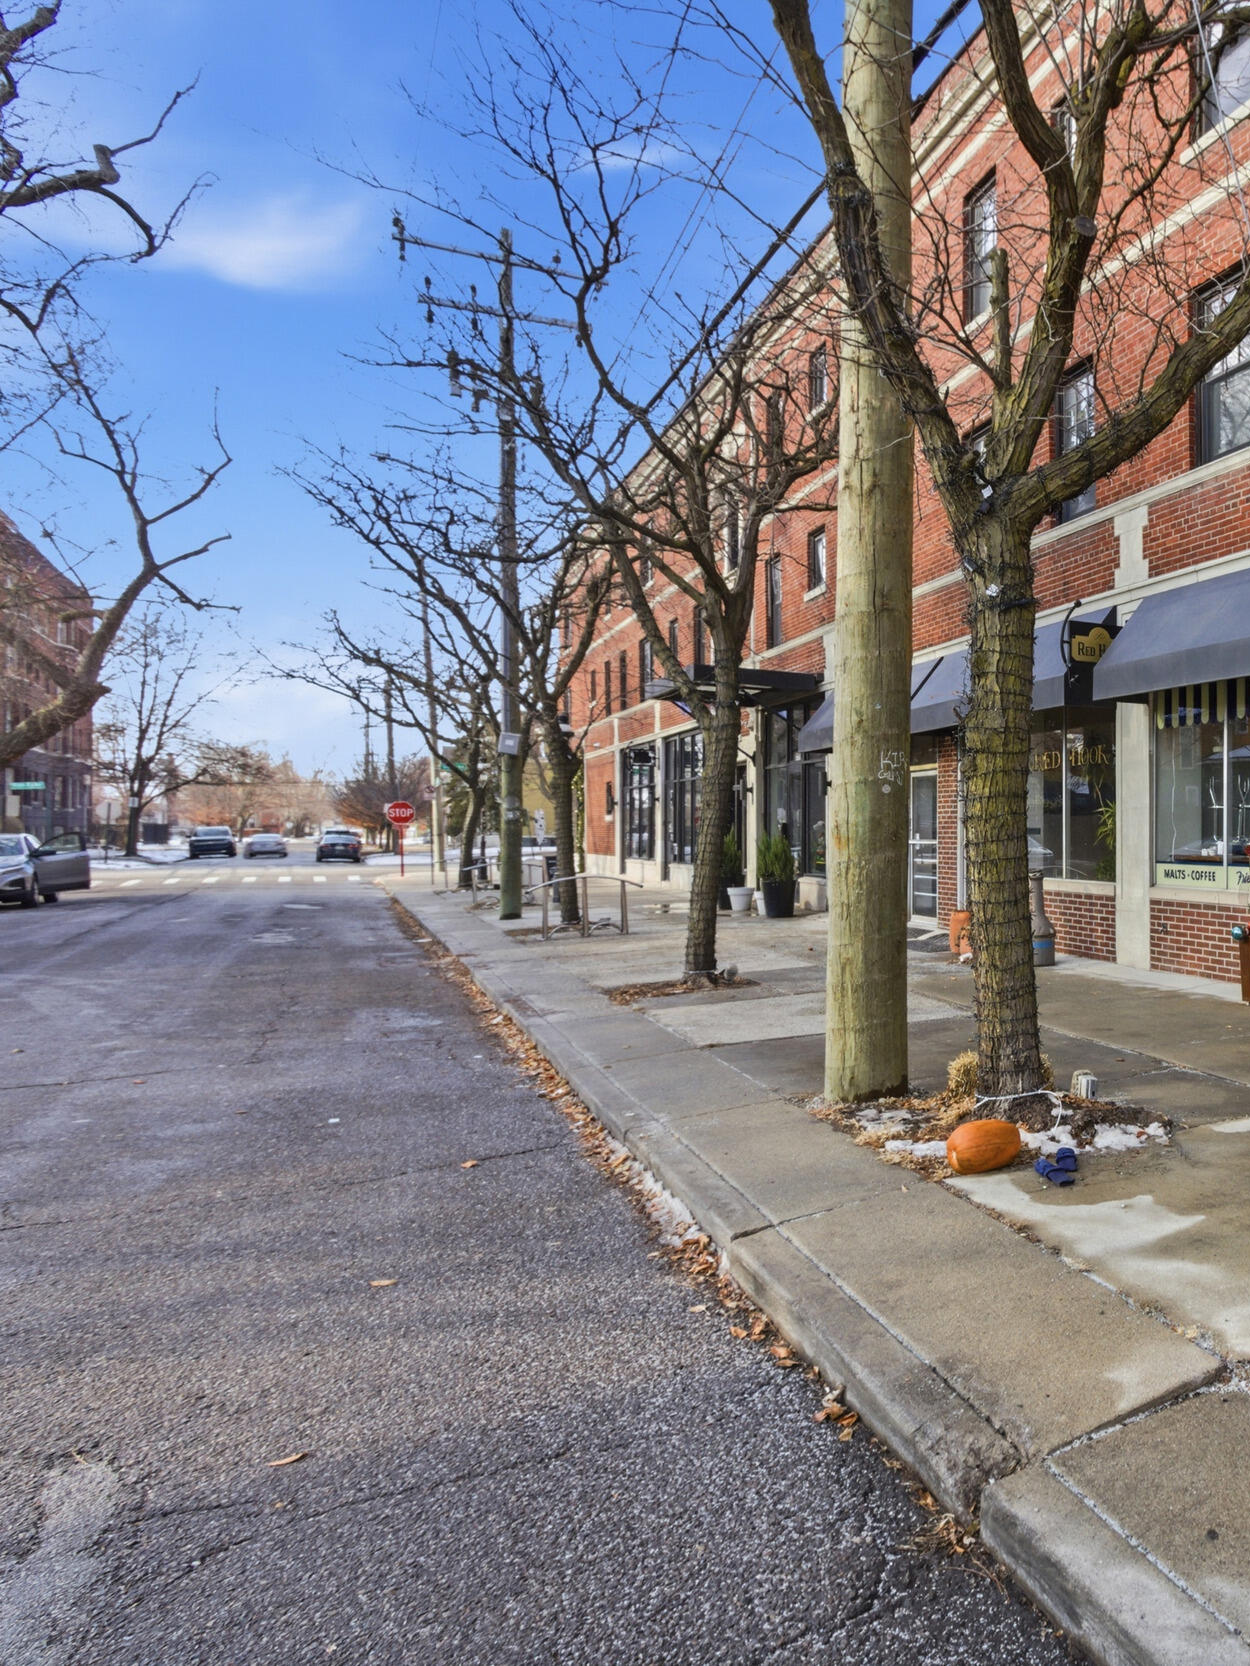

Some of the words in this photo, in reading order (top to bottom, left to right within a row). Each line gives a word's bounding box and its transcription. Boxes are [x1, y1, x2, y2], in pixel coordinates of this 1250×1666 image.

[1077, 642, 1096, 656] RED
[1069, 744, 1110, 766] HOOK
[388, 807, 414, 818] STOP
[1163, 869, 1186, 880] MALTS
[1191, 870, 1216, 882] COFFEE
